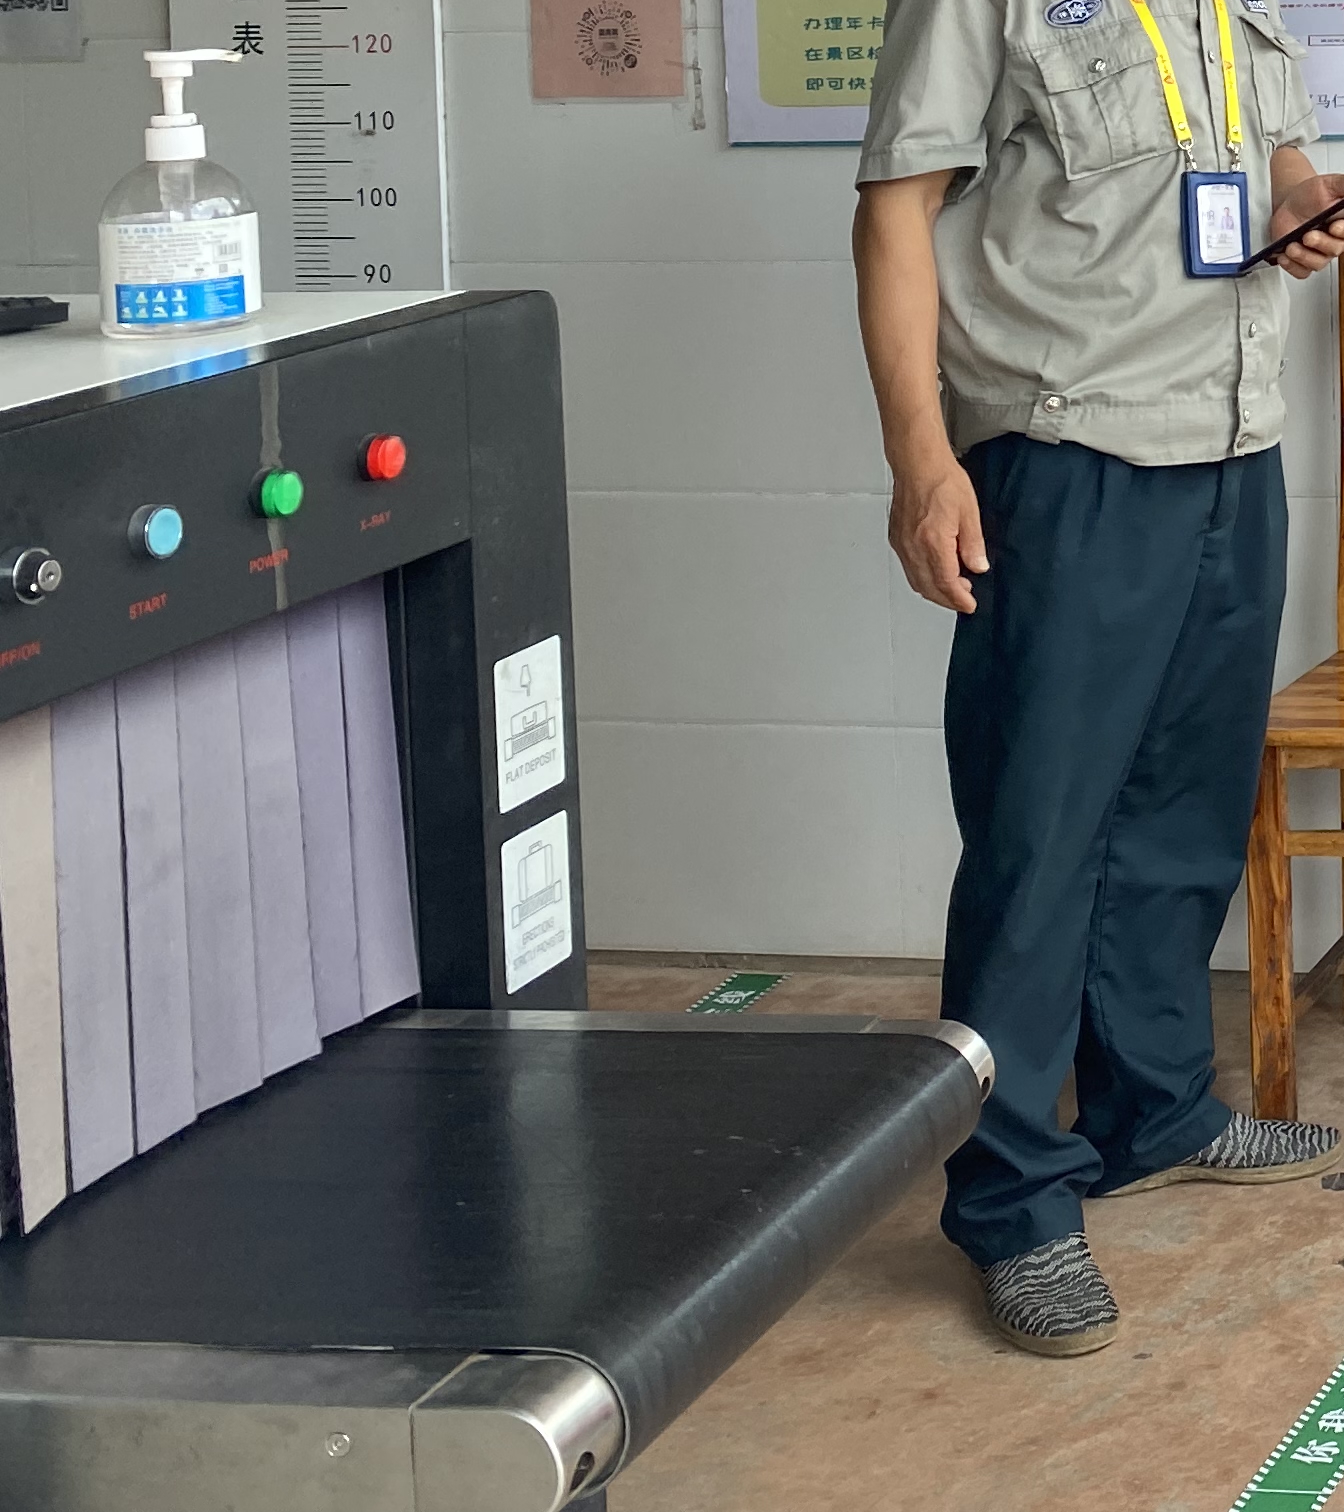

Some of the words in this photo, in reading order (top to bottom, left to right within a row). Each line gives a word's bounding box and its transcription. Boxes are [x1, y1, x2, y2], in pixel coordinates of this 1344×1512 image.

[803, 16, 885, 31] 办理年卡
[352, 34, 392, 54] 120
[806, 75, 873, 91] 即可快
[354, 111, 394, 131] 110
[356, 188, 397, 208] 100
[364, 264, 391, 284] 90
[359, 510, 391, 532] X-RAY
[248, 549, 289, 575] POWER
[128, 592, 168, 620] START
[505, 764, 524, 785] FLAT
[525, 748, 557, 775] DEPOSIT
